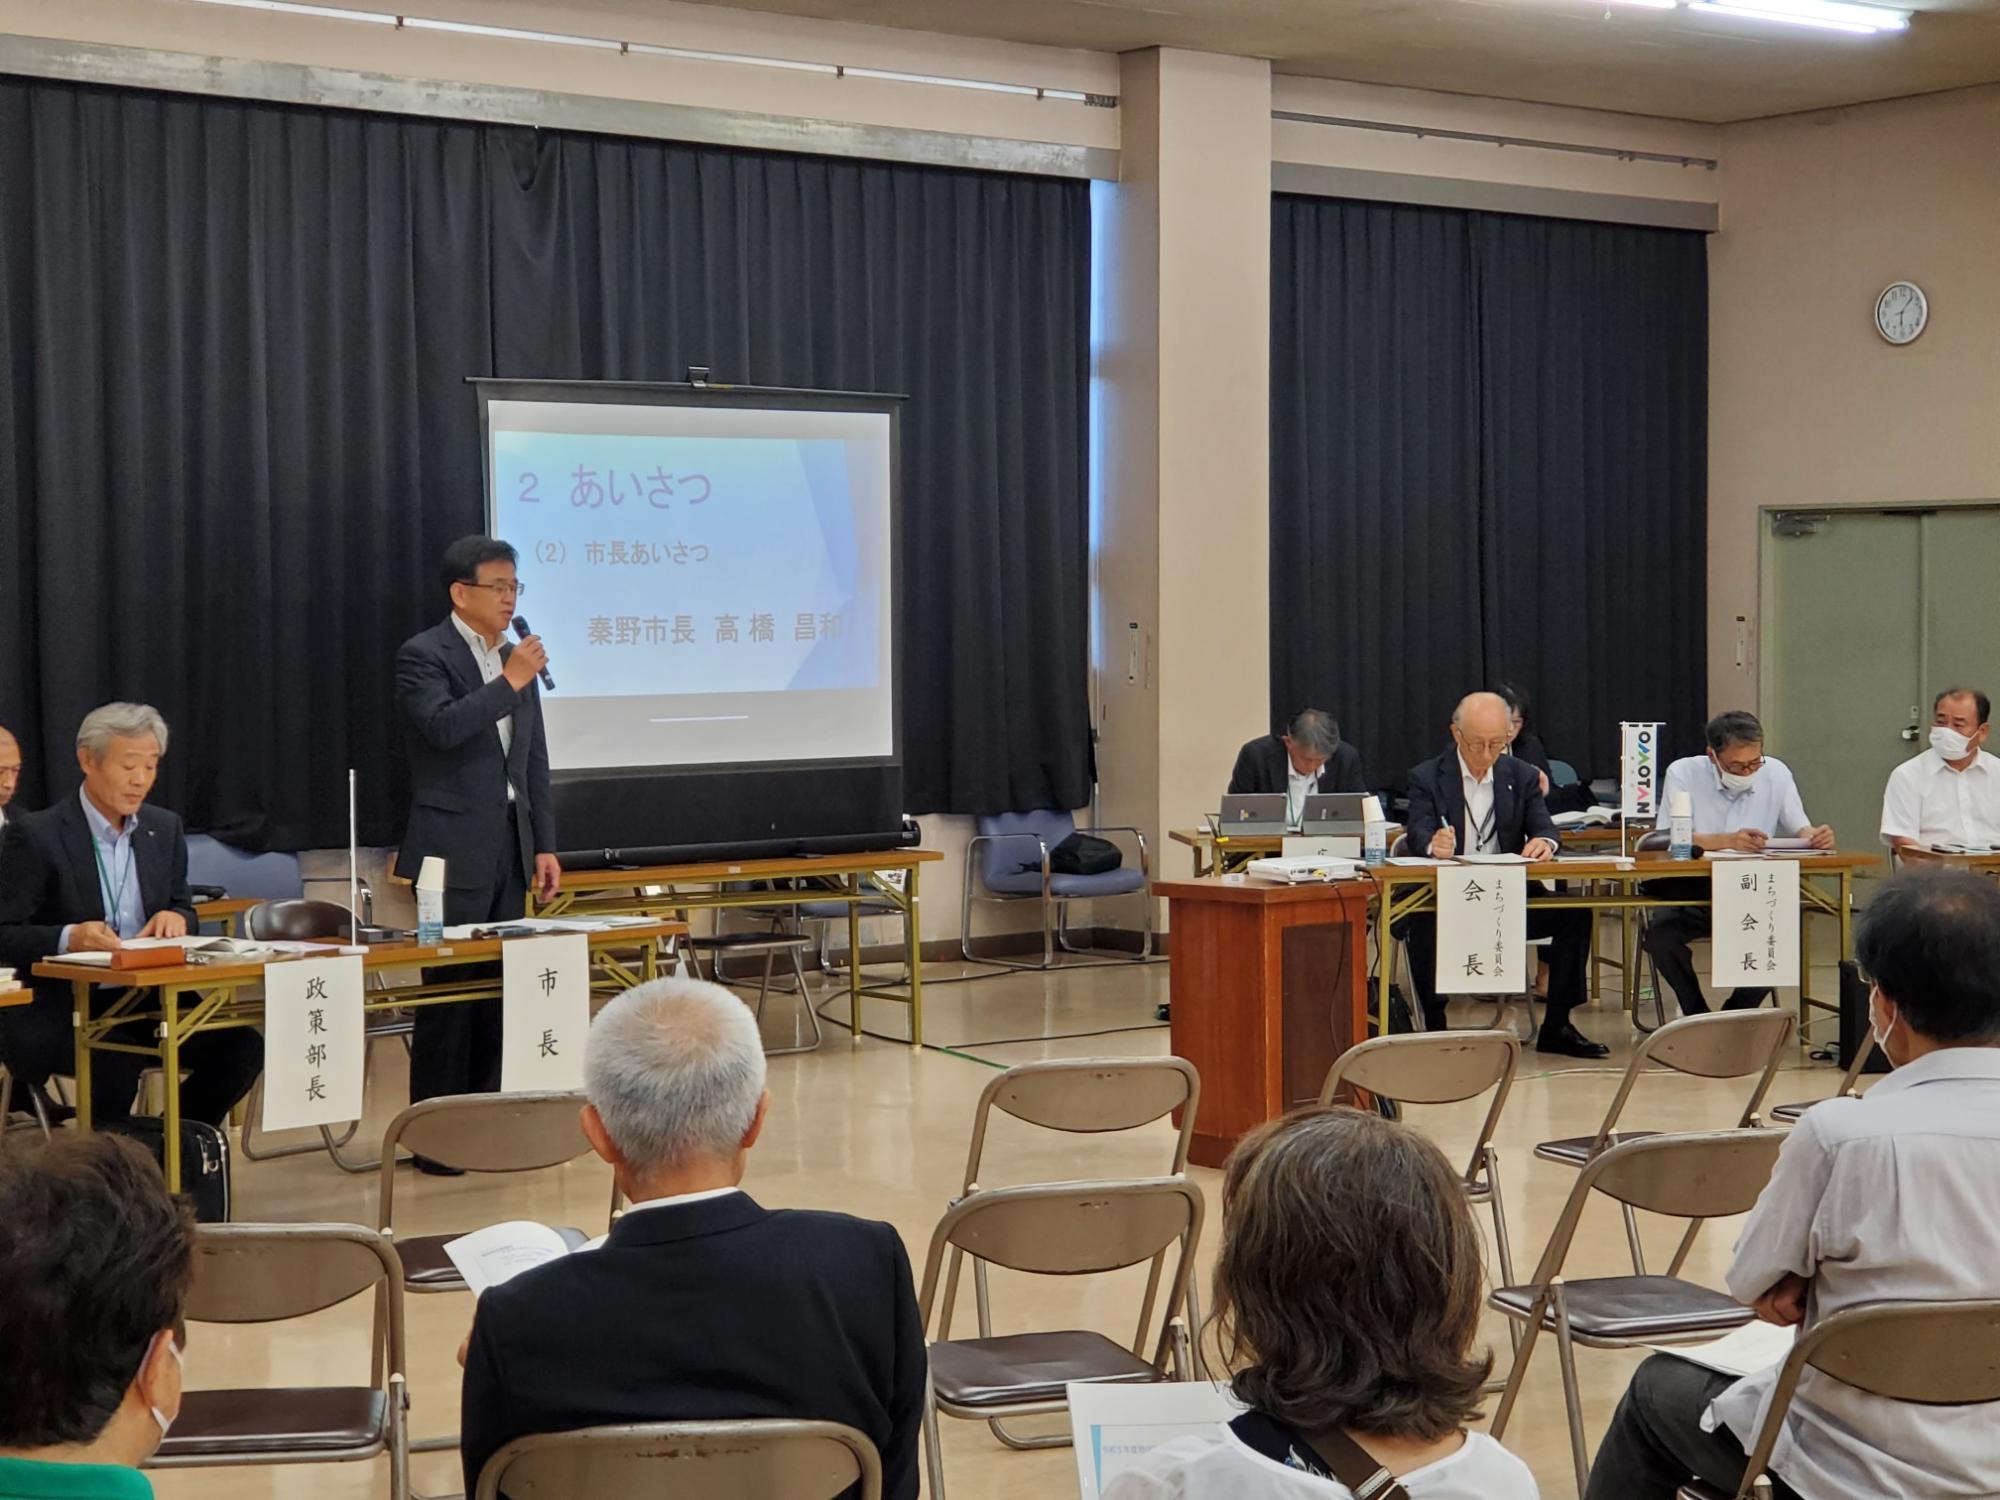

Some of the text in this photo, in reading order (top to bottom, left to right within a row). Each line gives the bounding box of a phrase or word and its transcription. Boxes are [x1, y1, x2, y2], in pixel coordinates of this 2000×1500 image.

[570, 465, 711, 509] あいさつ
[585, 541, 709, 566] 市長あいさつ
[588, 615, 696, 646] 秦野市長
[1463, 879, 1486, 976] 会長
[1494, 879, 1504, 977] まちづくり委員会
[1740, 873, 1759, 971] 副会長
[1766, 873, 1778, 971] まちづくり委員会
[305, 976, 328, 1101] 政策部長
[537, 967, 559, 1058] 市長
